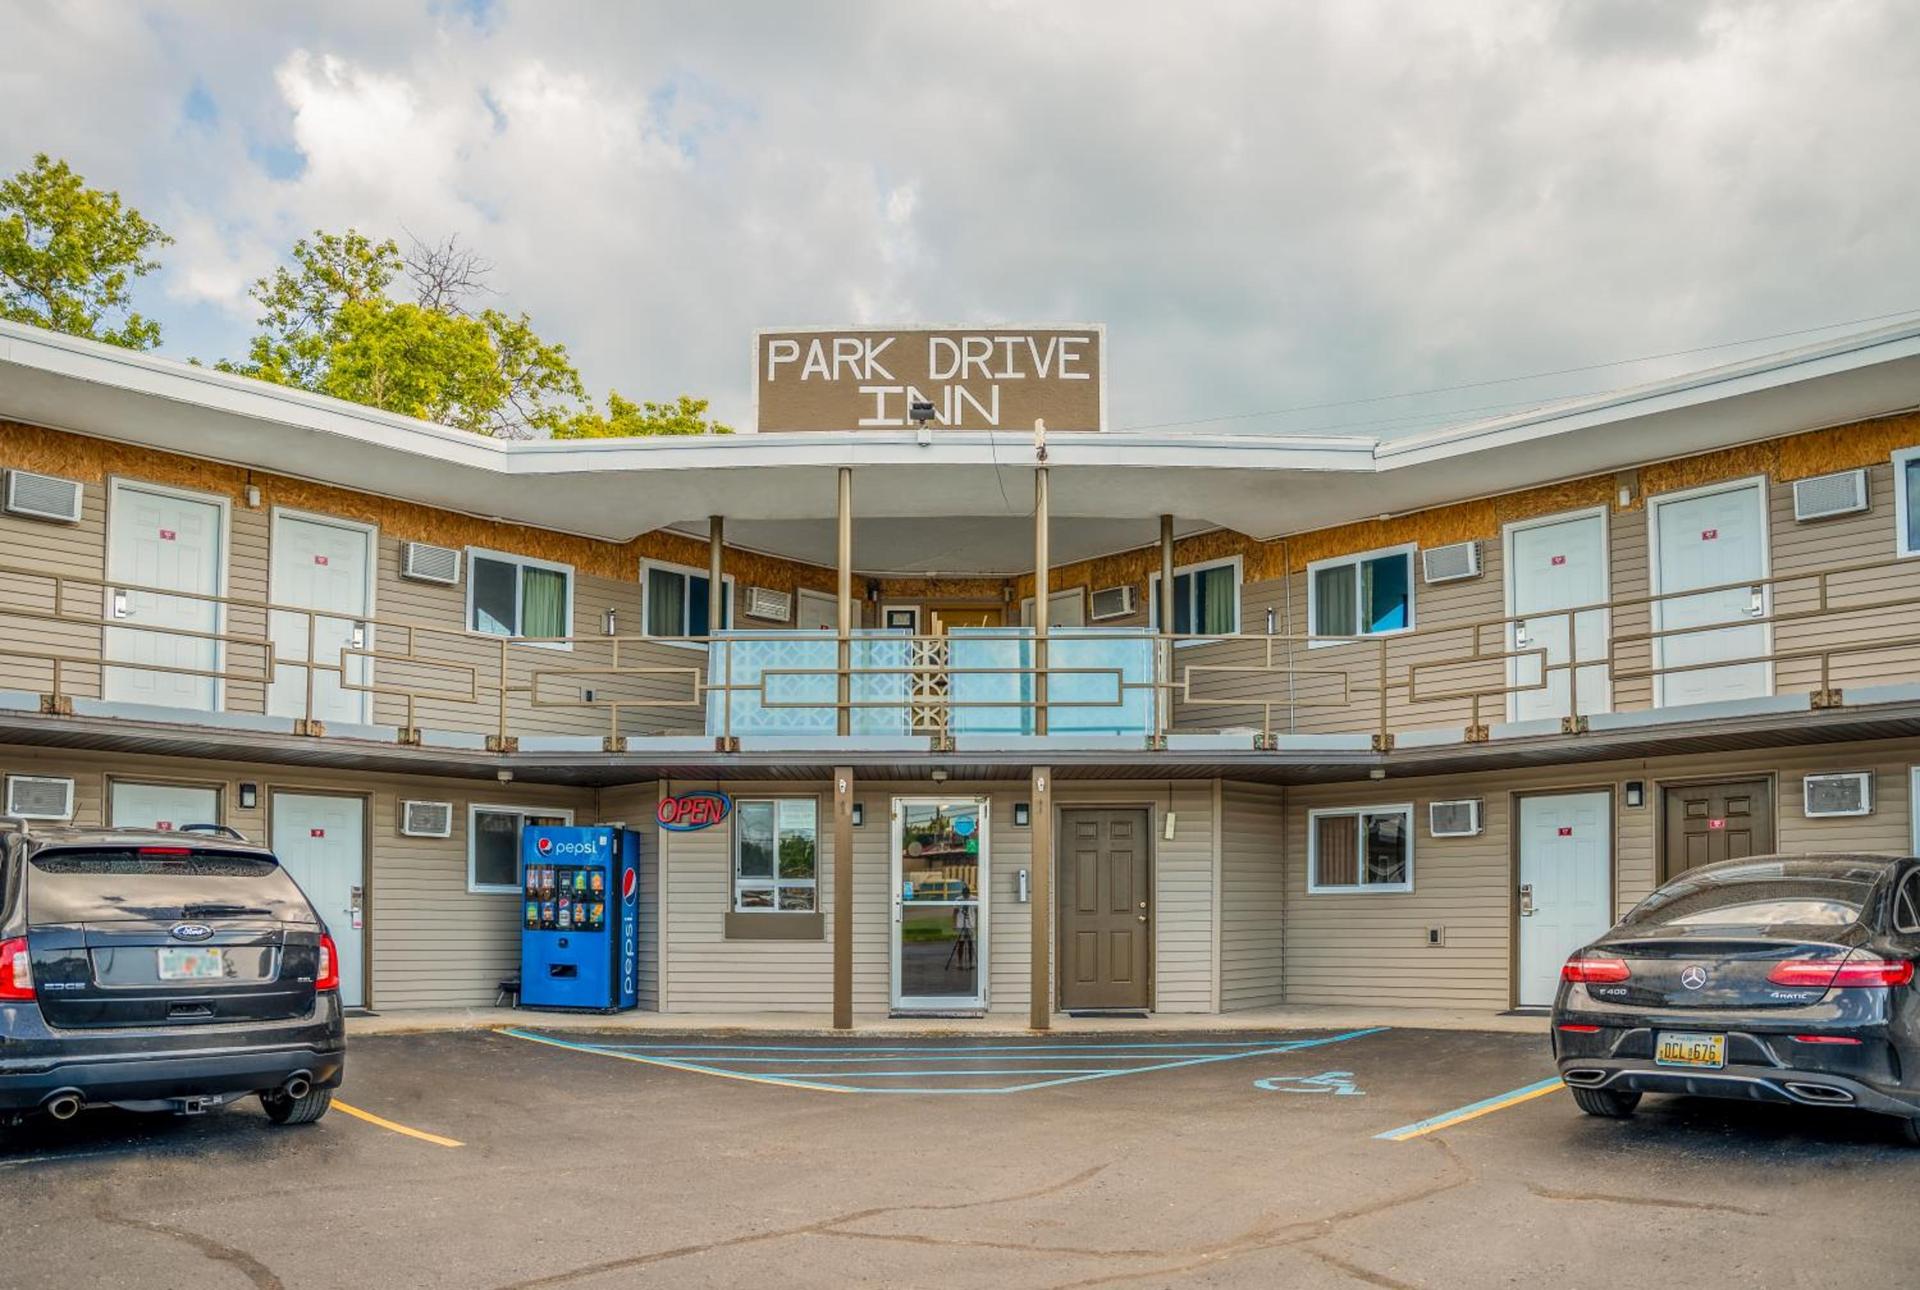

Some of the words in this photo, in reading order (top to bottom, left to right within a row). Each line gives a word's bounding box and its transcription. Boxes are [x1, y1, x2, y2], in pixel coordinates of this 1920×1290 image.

[768, 337, 896, 381] PARK
[929, 336, 1090, 380] DRIVE
[858, 385, 999, 426] INN
[657, 797, 723, 824] OPEN
[556, 840, 597, 856] pepsi
[624, 913, 634, 994] pepsi
[1607, 988, 1628, 996] 400
[1664, 1042, 1684, 1060] DCL
[1693, 1043, 1716, 1061] 676
